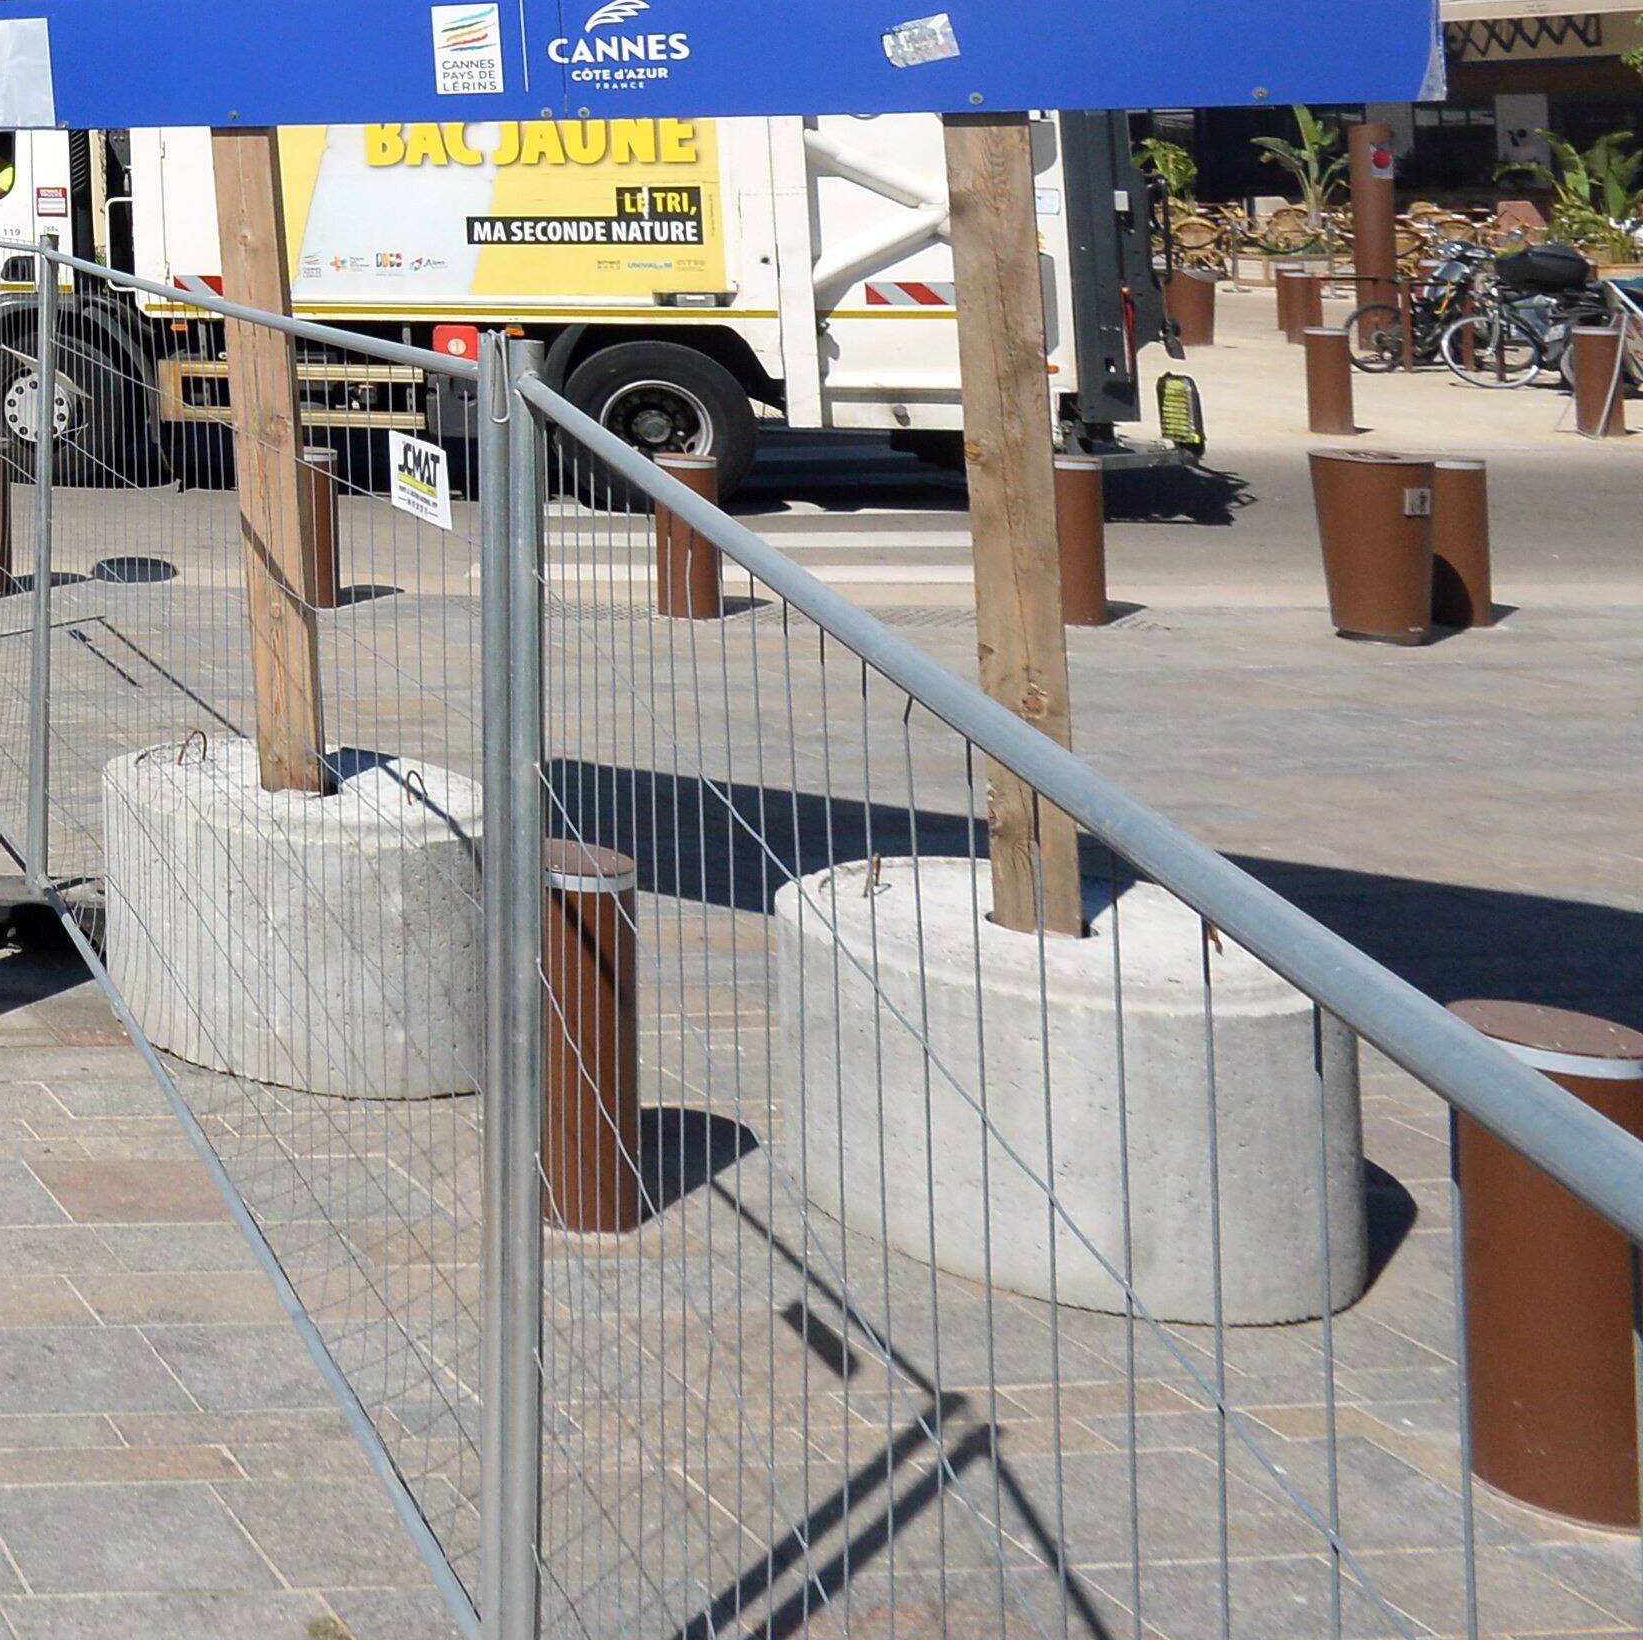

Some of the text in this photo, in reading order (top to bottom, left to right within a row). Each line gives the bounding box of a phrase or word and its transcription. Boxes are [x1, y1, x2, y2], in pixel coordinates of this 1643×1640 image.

[547, 32, 690, 65] CANNES
[442, 59, 495, 70] CANNES
[443, 71, 496, 80] PAYS DE
[571, 66, 611, 82] CÔTE
[443, 80, 497, 91] LÉRINS
[595, 82, 645, 90] FRANCE
[653, 192, 697, 216] TRI,
[473, 220, 698, 242] MA SECONDE NATURE
